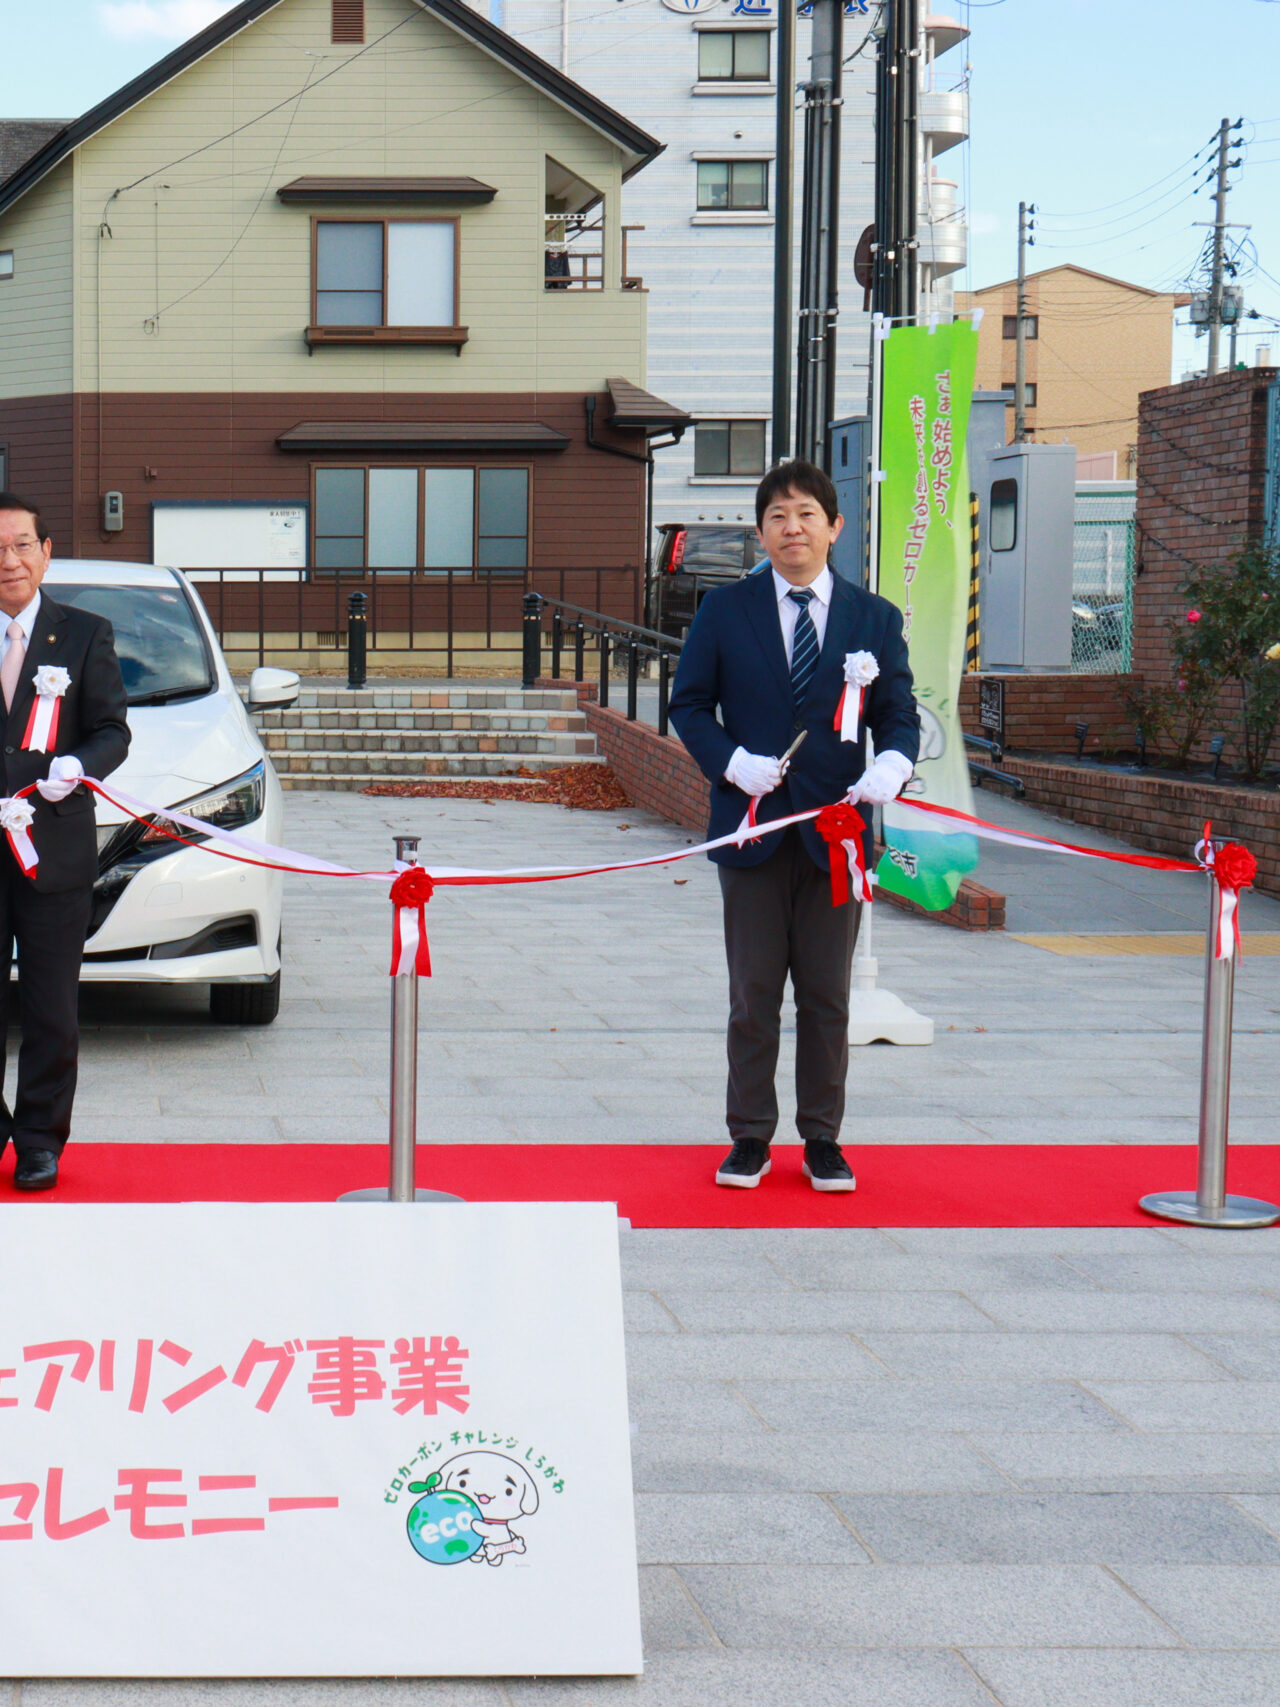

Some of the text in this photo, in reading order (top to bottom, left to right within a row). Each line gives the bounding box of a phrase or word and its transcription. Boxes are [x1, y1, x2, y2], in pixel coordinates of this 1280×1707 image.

[383, 1430, 566, 1504] ゼロカーボン チャレンジ しらかわ
[420, 1511, 475, 1544] eco
